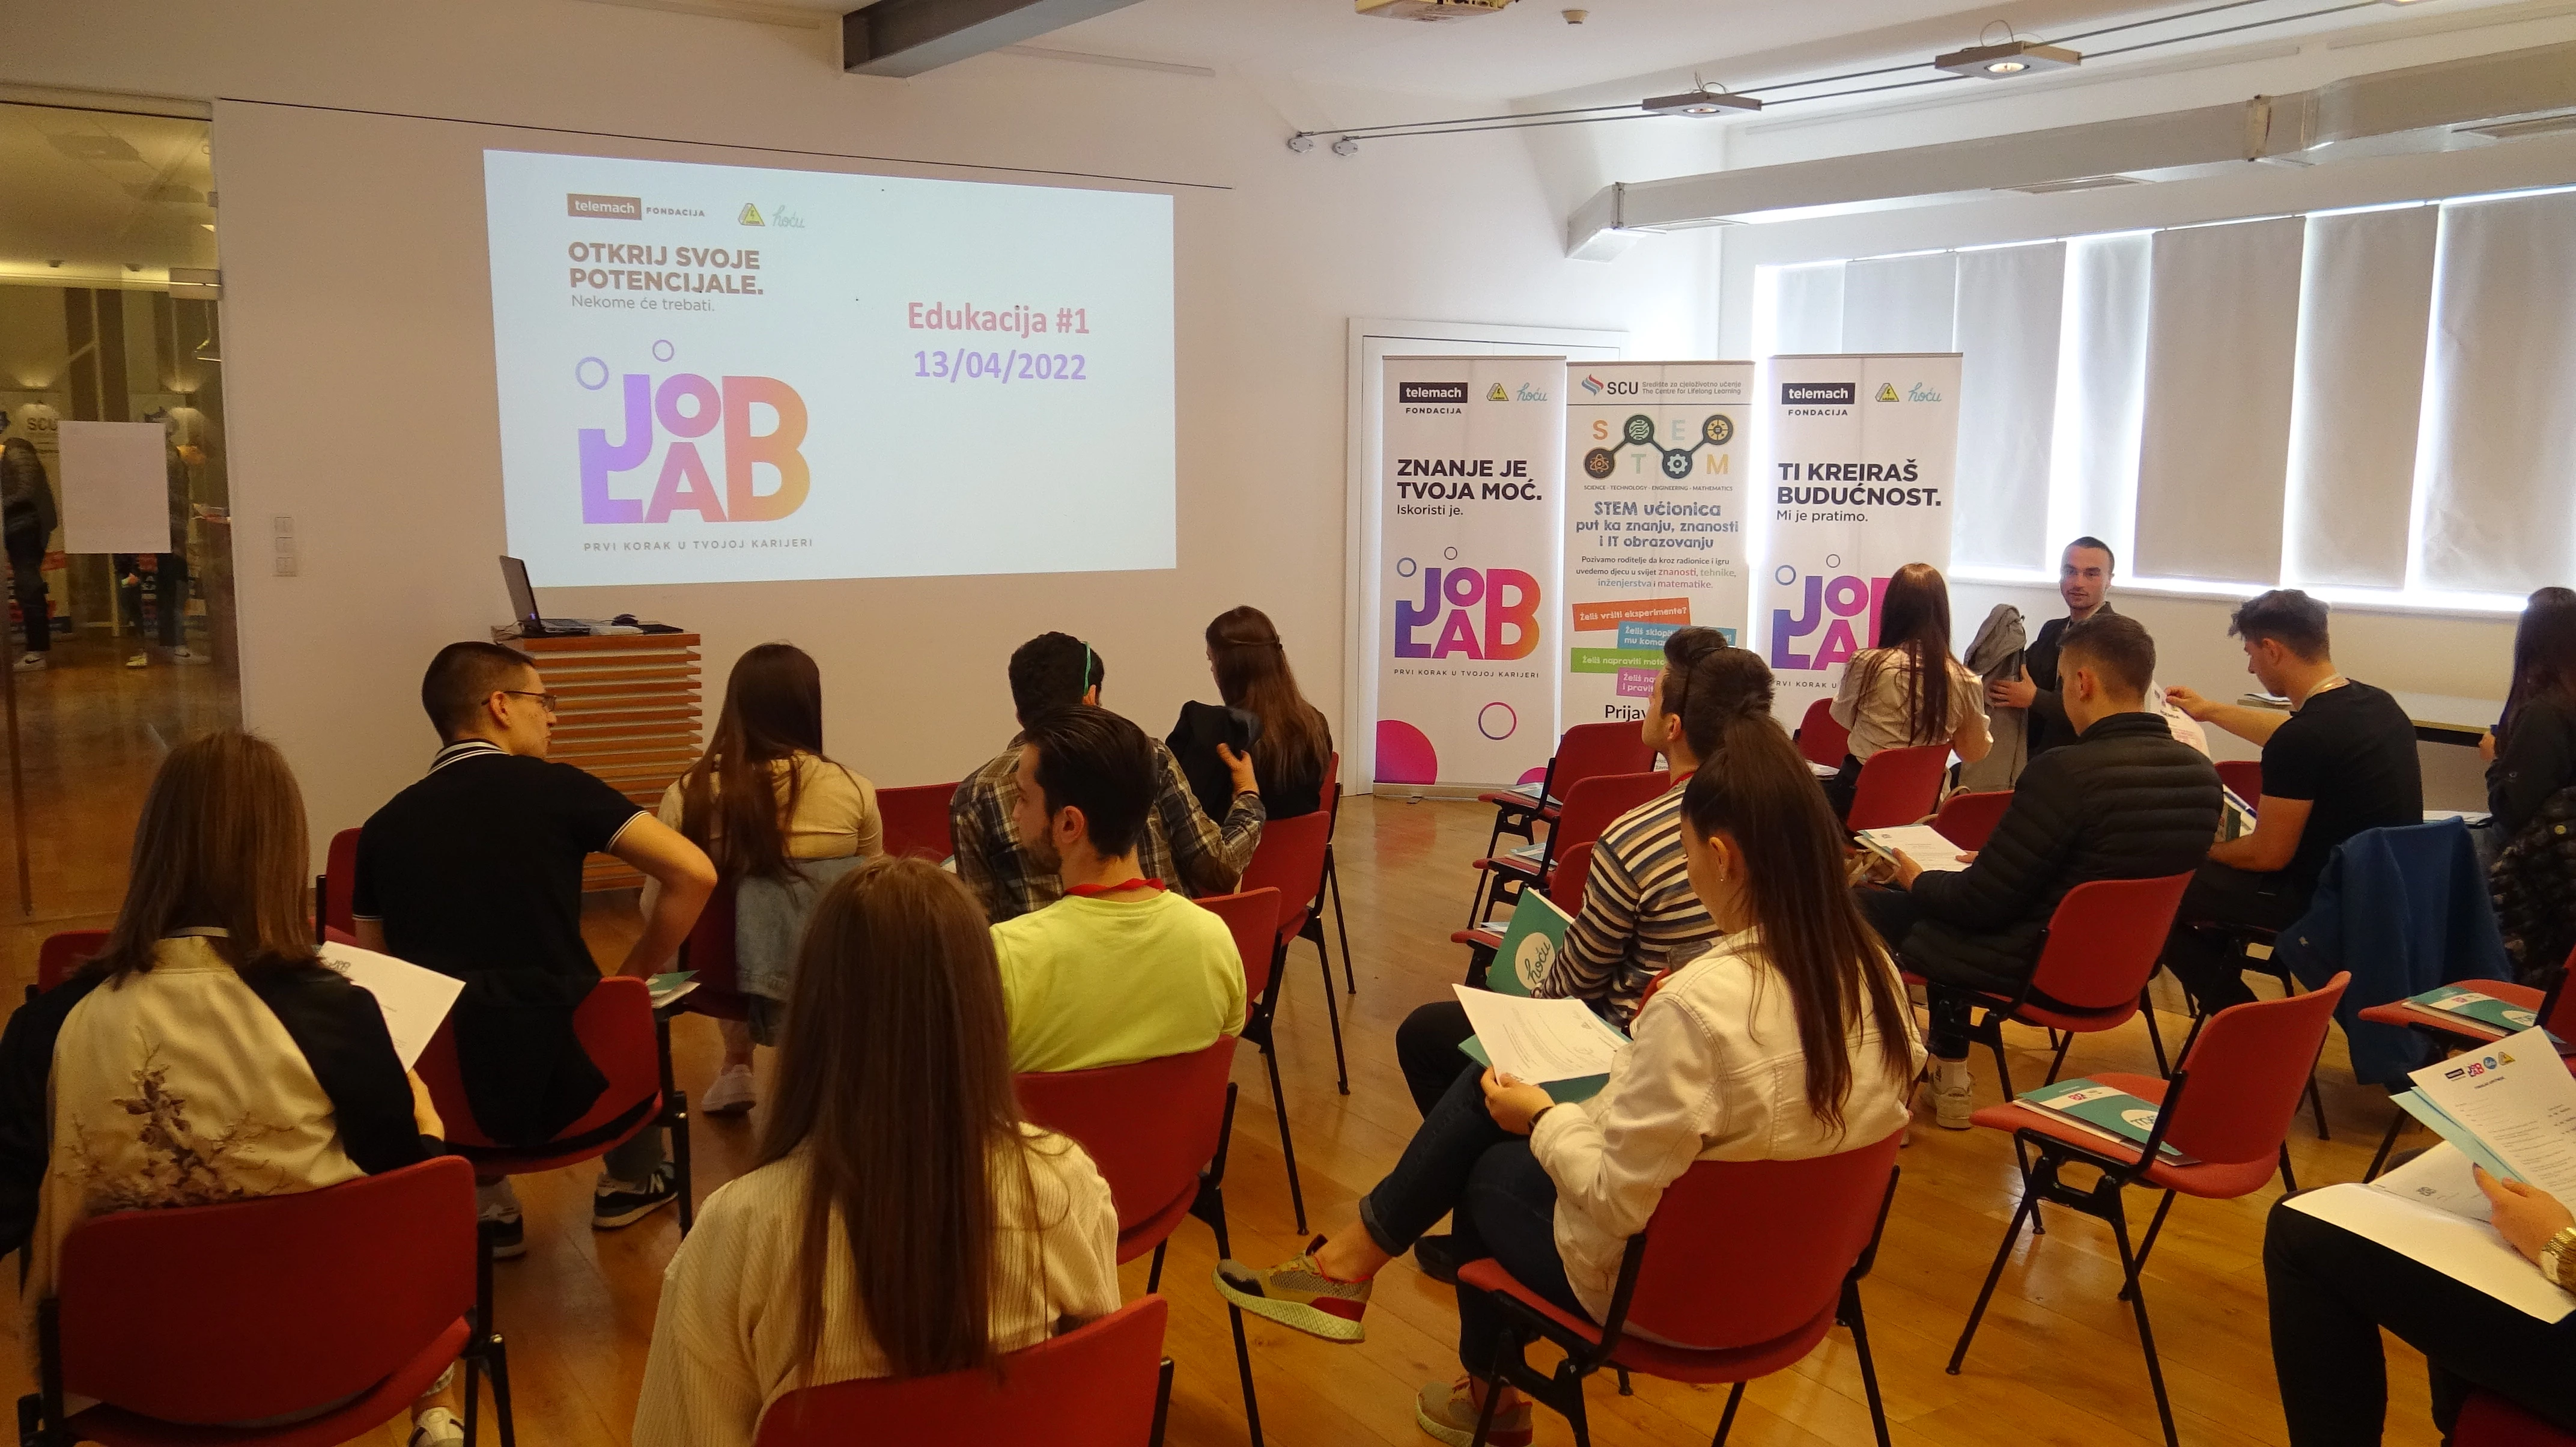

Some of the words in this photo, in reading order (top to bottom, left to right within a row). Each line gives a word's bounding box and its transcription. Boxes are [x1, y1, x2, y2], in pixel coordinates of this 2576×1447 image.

[575, 200, 635, 214] telemach
[646, 207, 705, 217] FONDACIJA
[568, 242, 667, 266] OTKRIJ
[675, 247, 761, 269] SVOJE
[570, 268, 764, 294] POTENCIJALE.
[572, 295, 635, 309] Nekome
[640, 295, 657, 310] će
[662, 297, 715, 312] trebati.
[908, 302, 1047, 338] Edukacija
[1056, 308, 1089, 334] #1
[914, 349, 1086, 384] 13/04/2022
[1406, 387, 1462, 398] telemach
[1516, 382, 1548, 401] hoću
[1607, 382, 1638, 395] SCU
[1788, 388, 1848, 399] telemach
[1908, 382, 1942, 401] hoću
[1397, 459, 1493, 477] ZNANJE
[1499, 460, 1527, 477] JE
[1778, 463, 1800, 481] TI
[1808, 458, 1918, 481] KREIRAŠ
[1397, 482, 1475, 499] TVOJA
[1481, 479, 1542, 501] MOĆ.
[1777, 483, 1941, 506] BUDUĆNOST.
[1397, 504, 1445, 515] Iskoristi
[1448, 505, 1463, 517] je.
[1594, 501, 1638, 516] STEM
[1644, 501, 1721, 516] učionica
[1777, 510, 1791, 520] Mi
[1795, 510, 1807, 523] je
[1812, 511, 1868, 523] pratimo.
[1576, 520, 1599, 533] put
[1604, 520, 1621, 531] ka
[1626, 520, 1675, 534] znanju,
[1680, 521, 1739, 532] znanosti
[584, 542, 616, 552] PRVI
[624, 541, 671, 551] KORAK
[678, 540, 686, 549] U
[693, 540, 745, 549] TVOJOJ
[752, 538, 813, 549] KARIJERI
[1599, 535, 1603, 547] i
[1608, 536, 1619, 547] IT
[1623, 536, 1714, 550] obrazovanju
[1617, 556, 1647, 565] roditelje
[1715, 558, 1730, 566] igru
[1610, 568, 1629, 577] djecu
[1638, 568, 1656, 577] svijet
[1700, 568, 1737, 577] tehnike,
[1598, 579, 1652, 588] inženjerstva
[1657, 580, 1713, 589] matematike.
[1580, 612, 1598, 621] Želiš
[1600, 611, 1622, 620] vršiti
[1624, 606, 1687, 618] eksperimente?
[1625, 626, 1644, 635] Želiš
[1582, 655, 1600, 664] Želiš
[1623, 672, 1642, 681] Želiš
